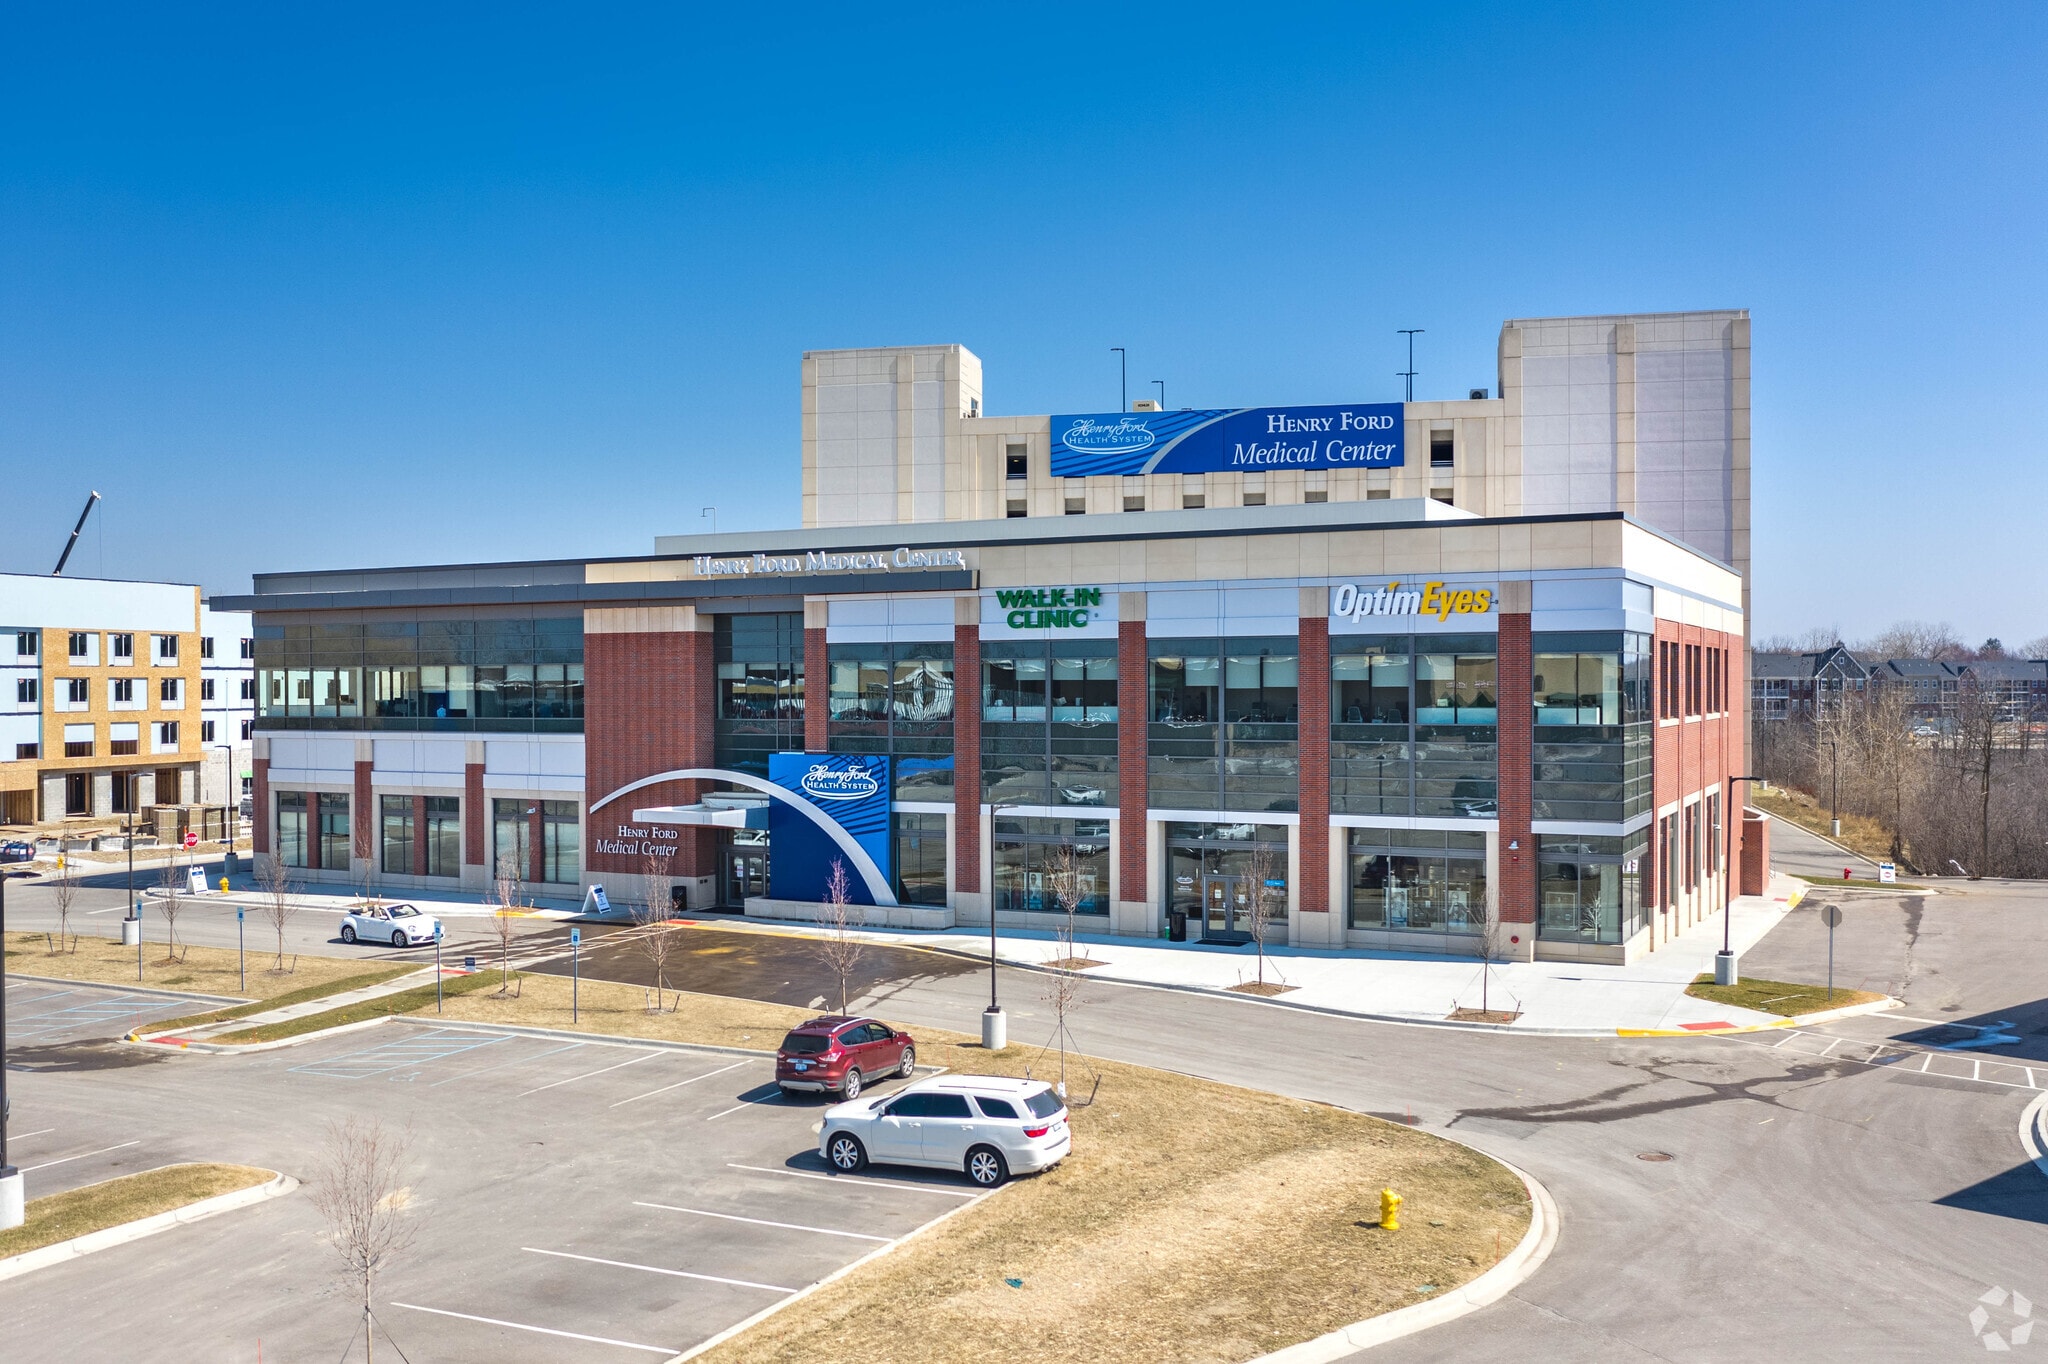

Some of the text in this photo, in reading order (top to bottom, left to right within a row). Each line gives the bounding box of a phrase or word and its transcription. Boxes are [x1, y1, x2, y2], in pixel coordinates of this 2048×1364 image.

[1071, 417, 1149, 438] Henry Ford
[1266, 411, 1395, 434] HENRY FORD
[1069, 434, 1152, 445] HEALTH SYSTEM
[1231, 439, 1397, 465] Medical Center
[804, 550, 889, 571] MEDICAL
[892, 547, 966, 569] CENTER
[995, 587, 1101, 609] WALK-IN
[1333, 580, 1492, 624] OptimEyes
[1006, 608, 1089, 629] CLINIC
[808, 764, 872, 784] Henry Ford
[806, 781, 875, 790] HEALTH SYSTEM
[618, 825, 678, 839] HENRY FORD
[594, 838, 678, 857] Medical Center
